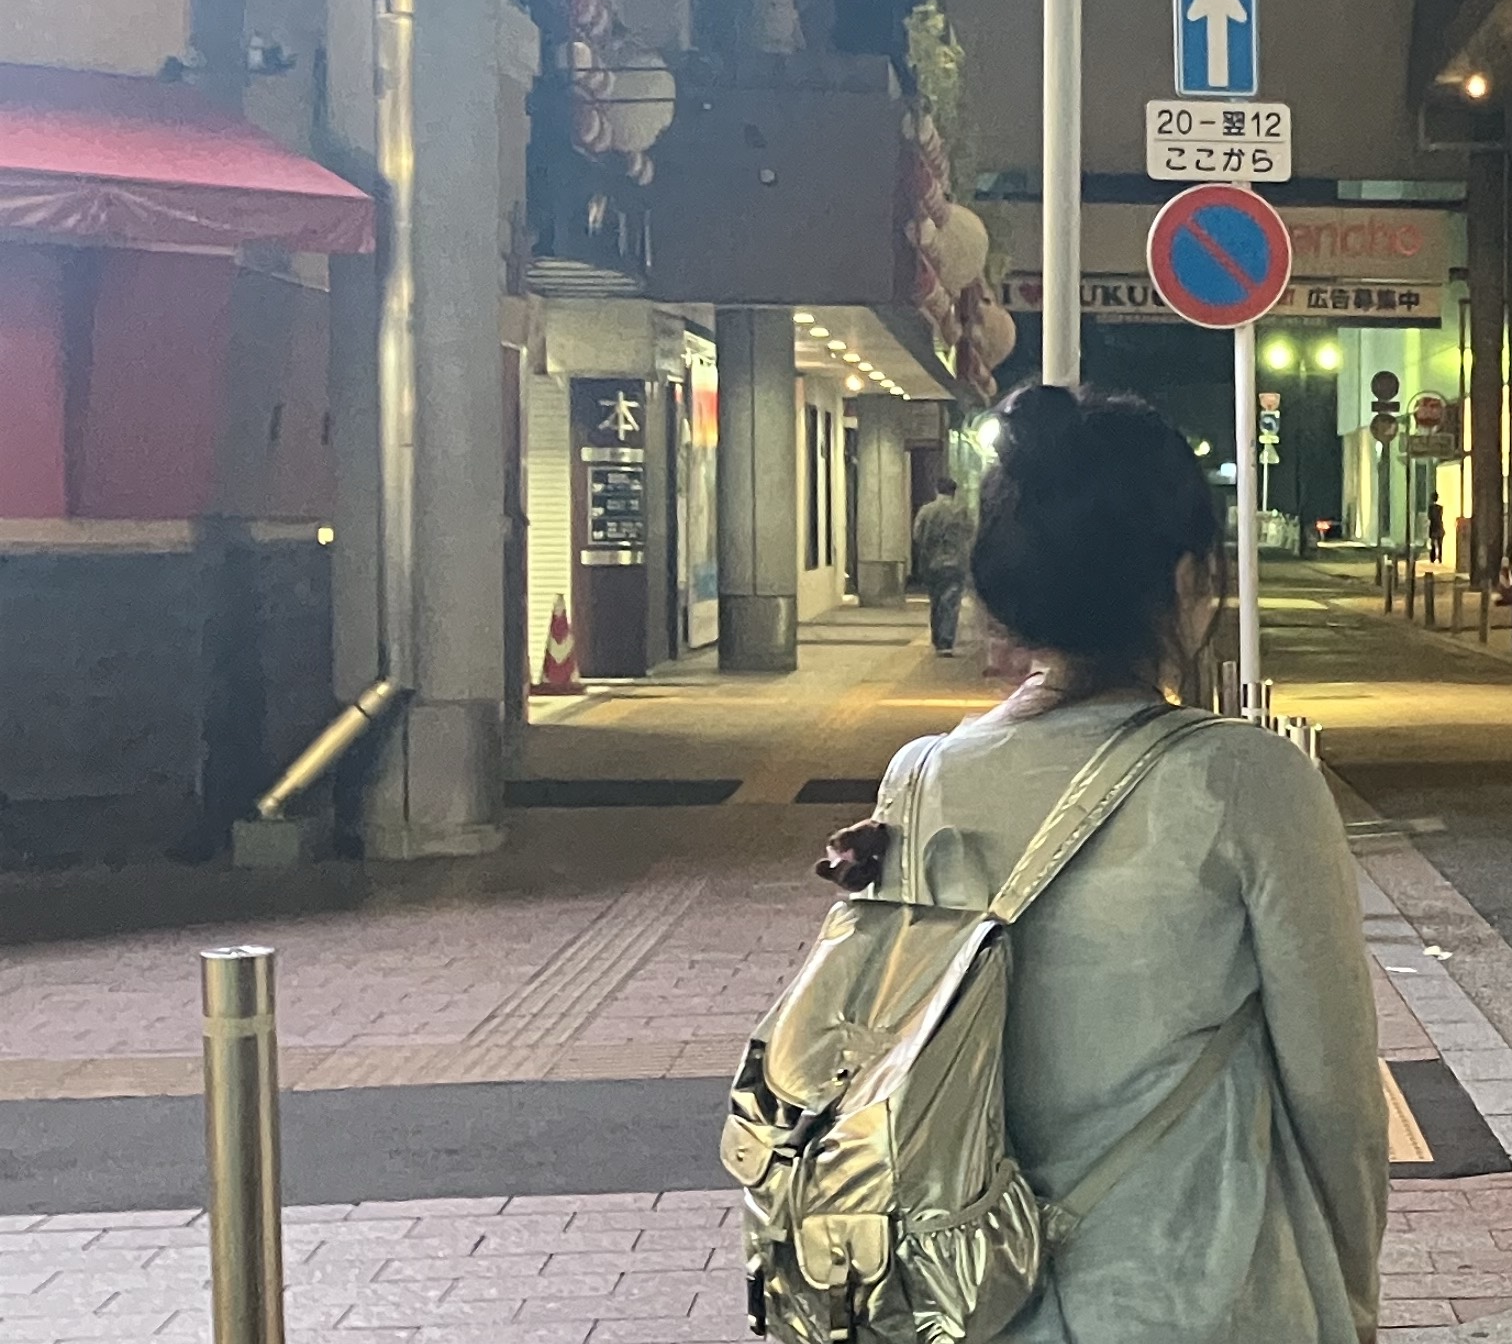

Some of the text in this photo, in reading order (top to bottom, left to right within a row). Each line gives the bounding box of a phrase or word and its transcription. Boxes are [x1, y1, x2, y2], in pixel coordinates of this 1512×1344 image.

[1165, 147, 1274, 173] ここから
[598, 390, 641, 441] 本
